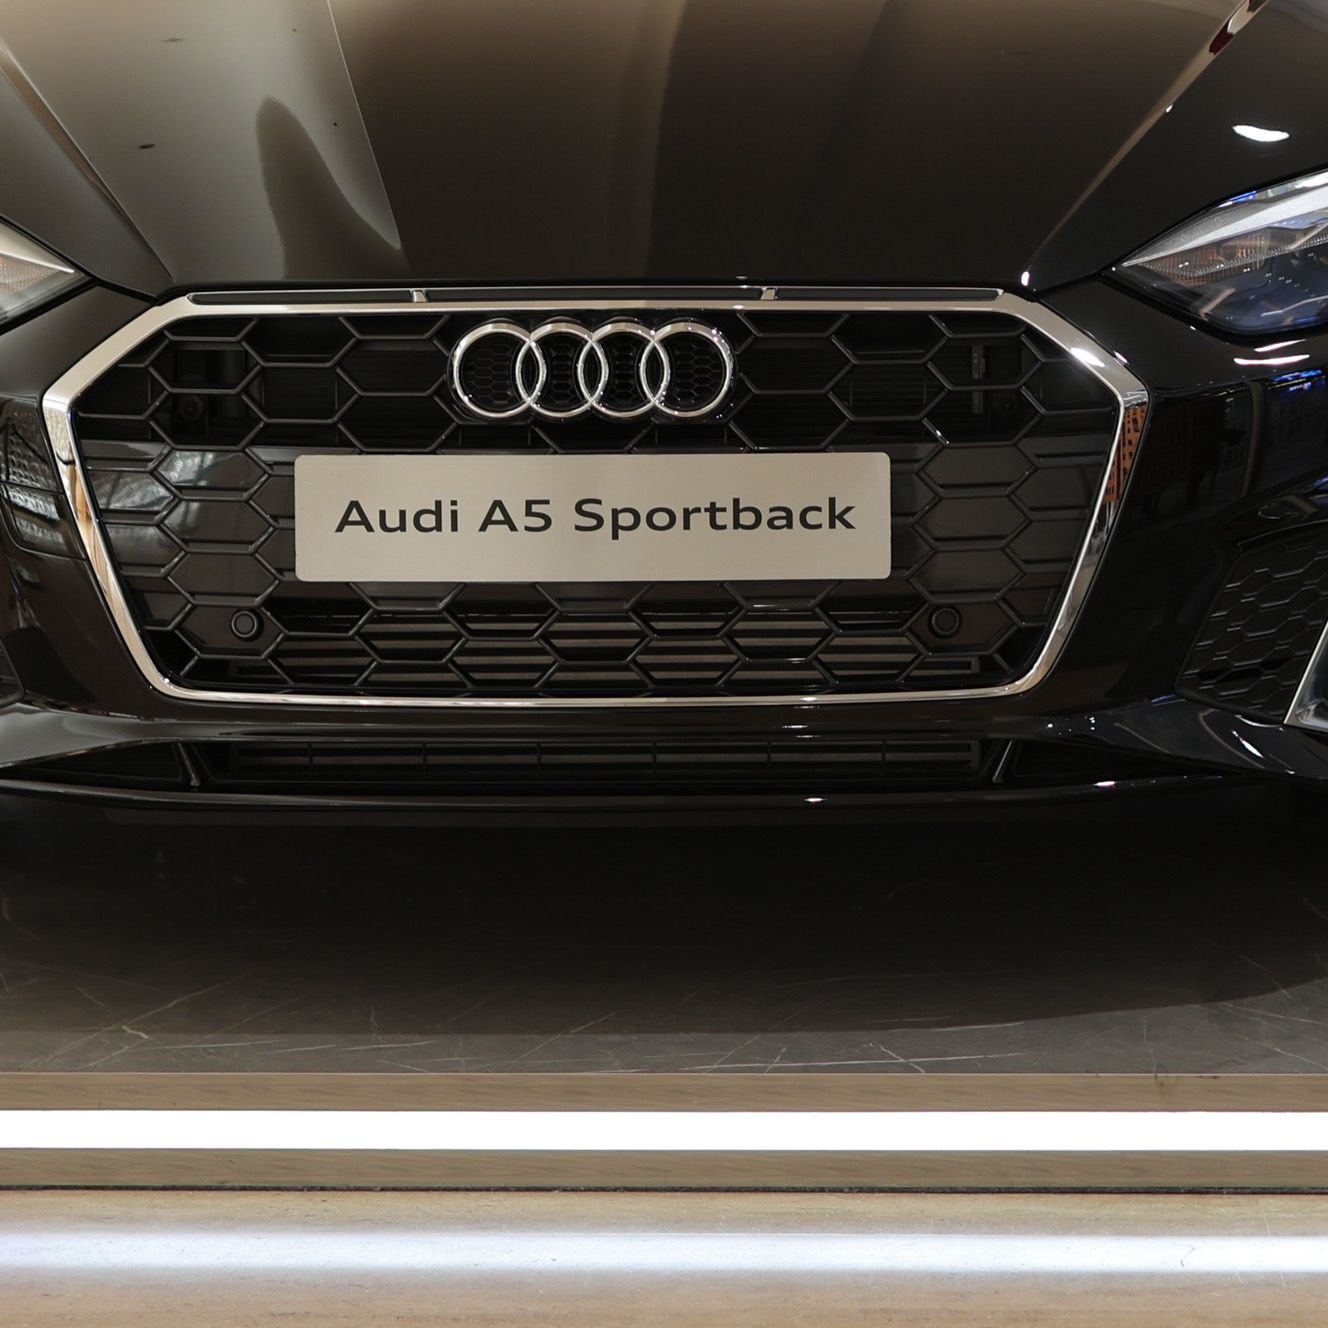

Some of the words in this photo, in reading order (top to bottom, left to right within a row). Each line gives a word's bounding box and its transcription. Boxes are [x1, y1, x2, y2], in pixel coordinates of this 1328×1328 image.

[334, 499, 460, 534] Audi
[478, 499, 554, 533] A5
[573, 496, 858, 541] Sportback
